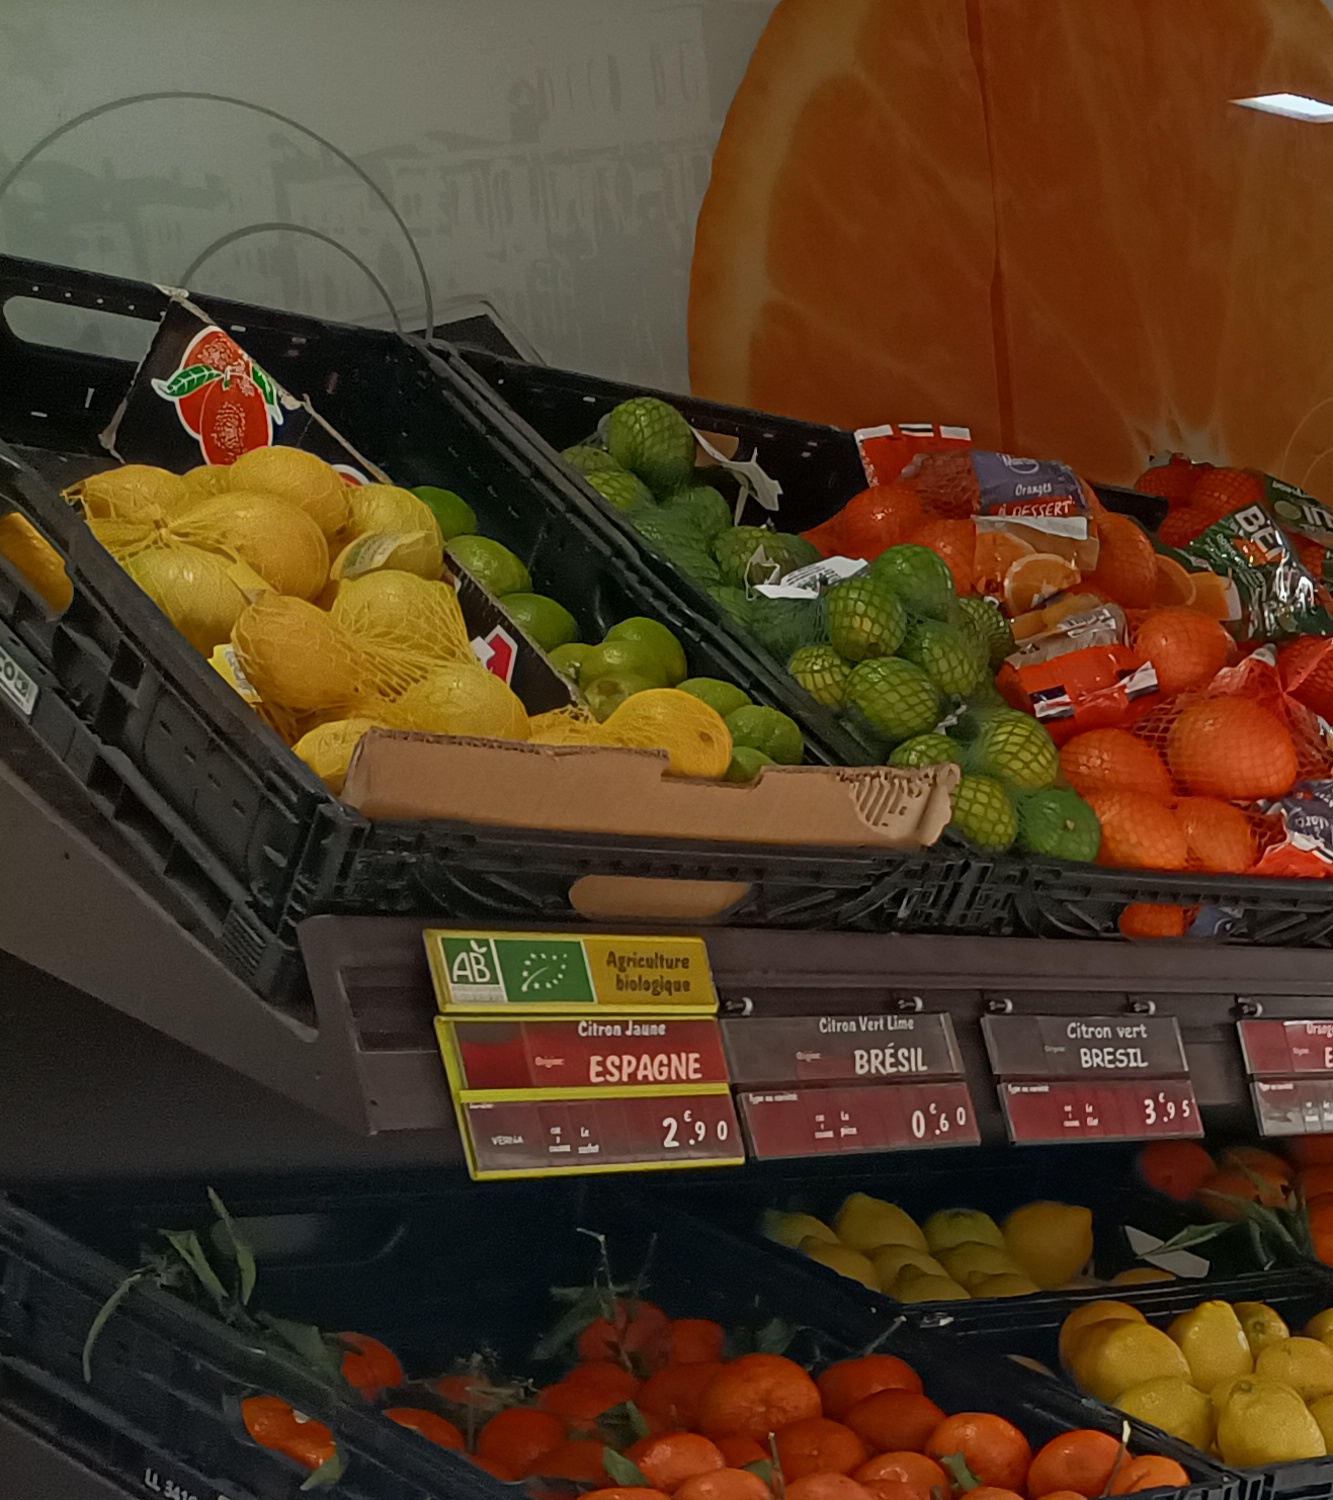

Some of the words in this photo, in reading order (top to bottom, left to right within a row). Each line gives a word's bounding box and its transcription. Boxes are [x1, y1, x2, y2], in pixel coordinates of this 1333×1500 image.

[606, 951, 691, 971] Agriculture
[614, 973, 692, 995] biologique
[578, 1020, 623, 1038] Citron
[625, 1020, 667, 1037] Jaune
[819, 1016, 857, 1034] Citron
[859, 1016, 885, 1033] Vert
[887, 1014, 915, 1031] Lime
[1066, 1021, 1112, 1040] Citron
[1116, 1023, 1148, 1039] vert
[589, 1052, 703, 1083] ESPAGNE
[854, 1042, 928, 1075] BRÉSIL
[1080, 1047, 1149, 1069] BRESIL
